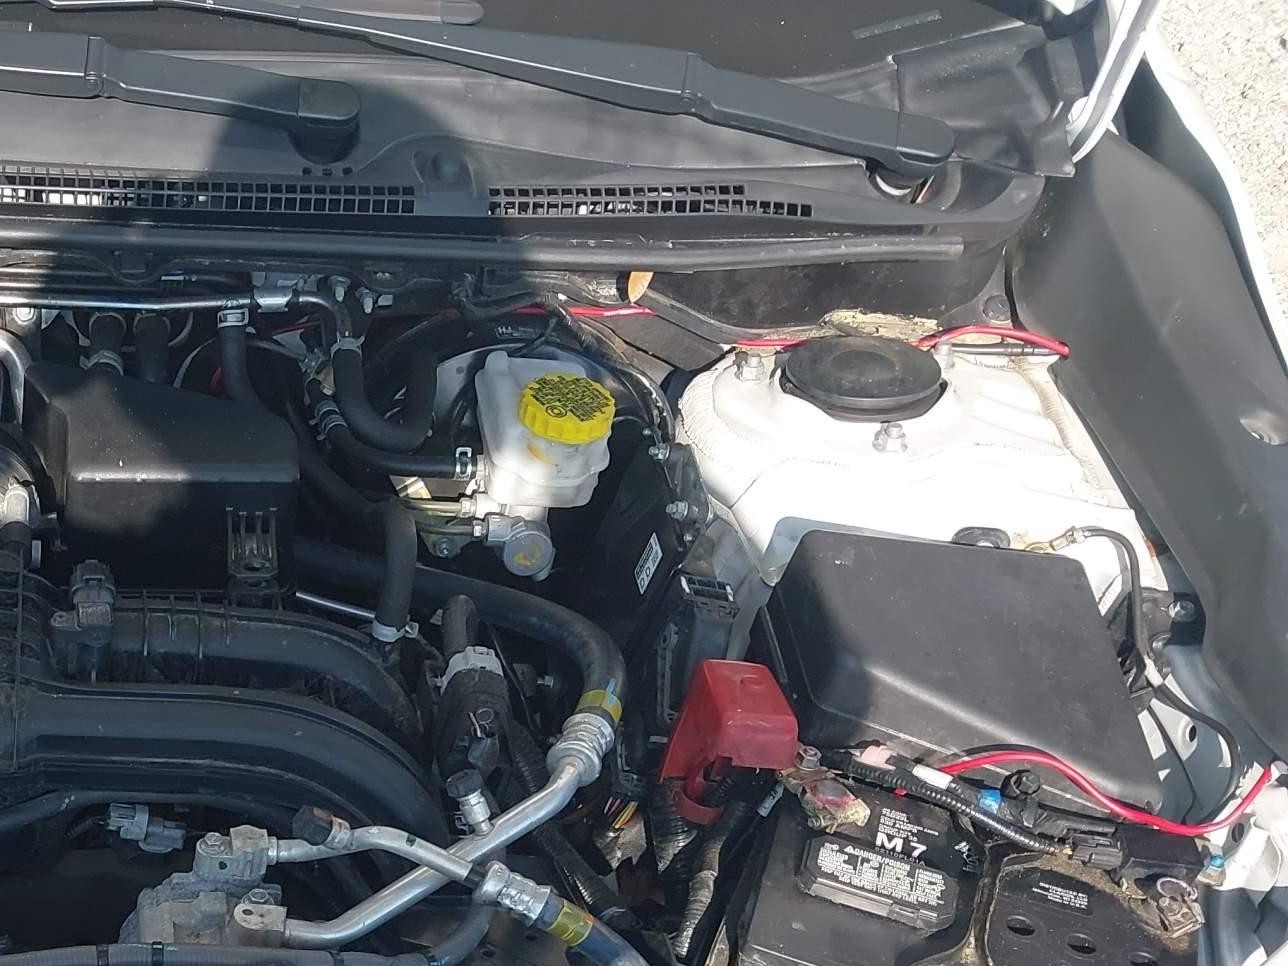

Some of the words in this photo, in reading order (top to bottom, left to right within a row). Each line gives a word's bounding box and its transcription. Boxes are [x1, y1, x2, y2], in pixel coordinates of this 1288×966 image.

[875, 831, 903, 853] M
[910, 841, 927, 858] 7
[853, 848, 911, 870] DANGER/POISON
